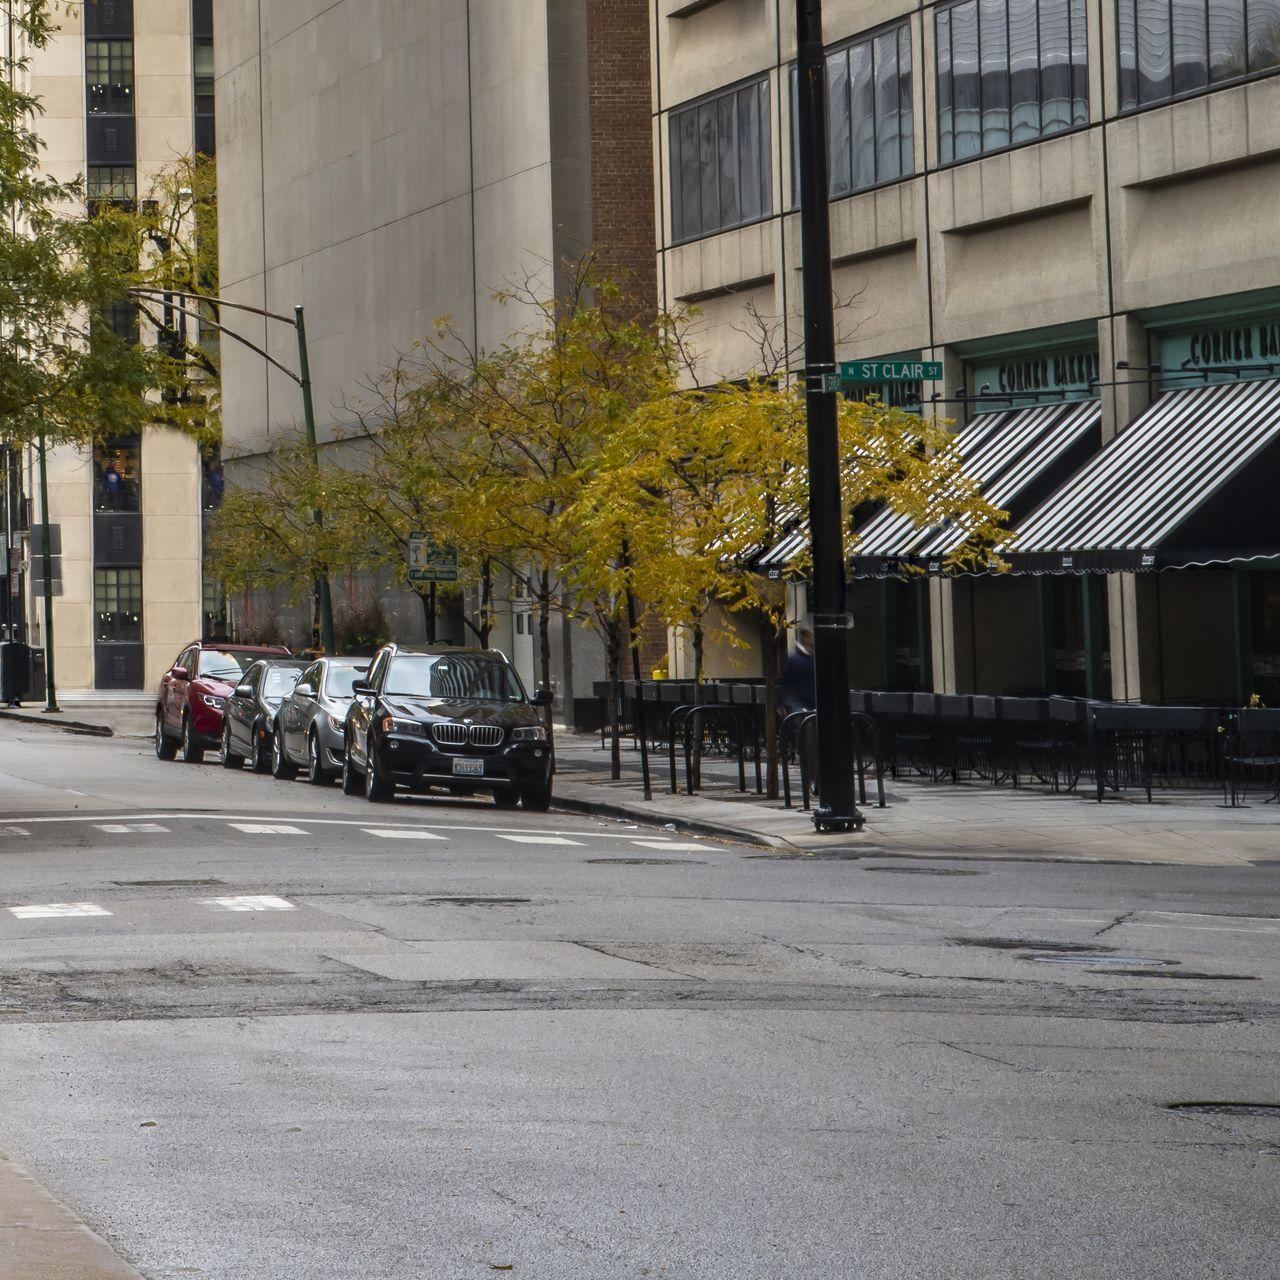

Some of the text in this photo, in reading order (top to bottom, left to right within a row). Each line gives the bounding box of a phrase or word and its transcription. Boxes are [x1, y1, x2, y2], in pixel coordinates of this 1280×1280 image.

[1190, 322, 1280, 366] CORNER BA
[848, 363, 938, 378] N ST CLAIR ST
[998, 357, 1049, 393] CORNER
